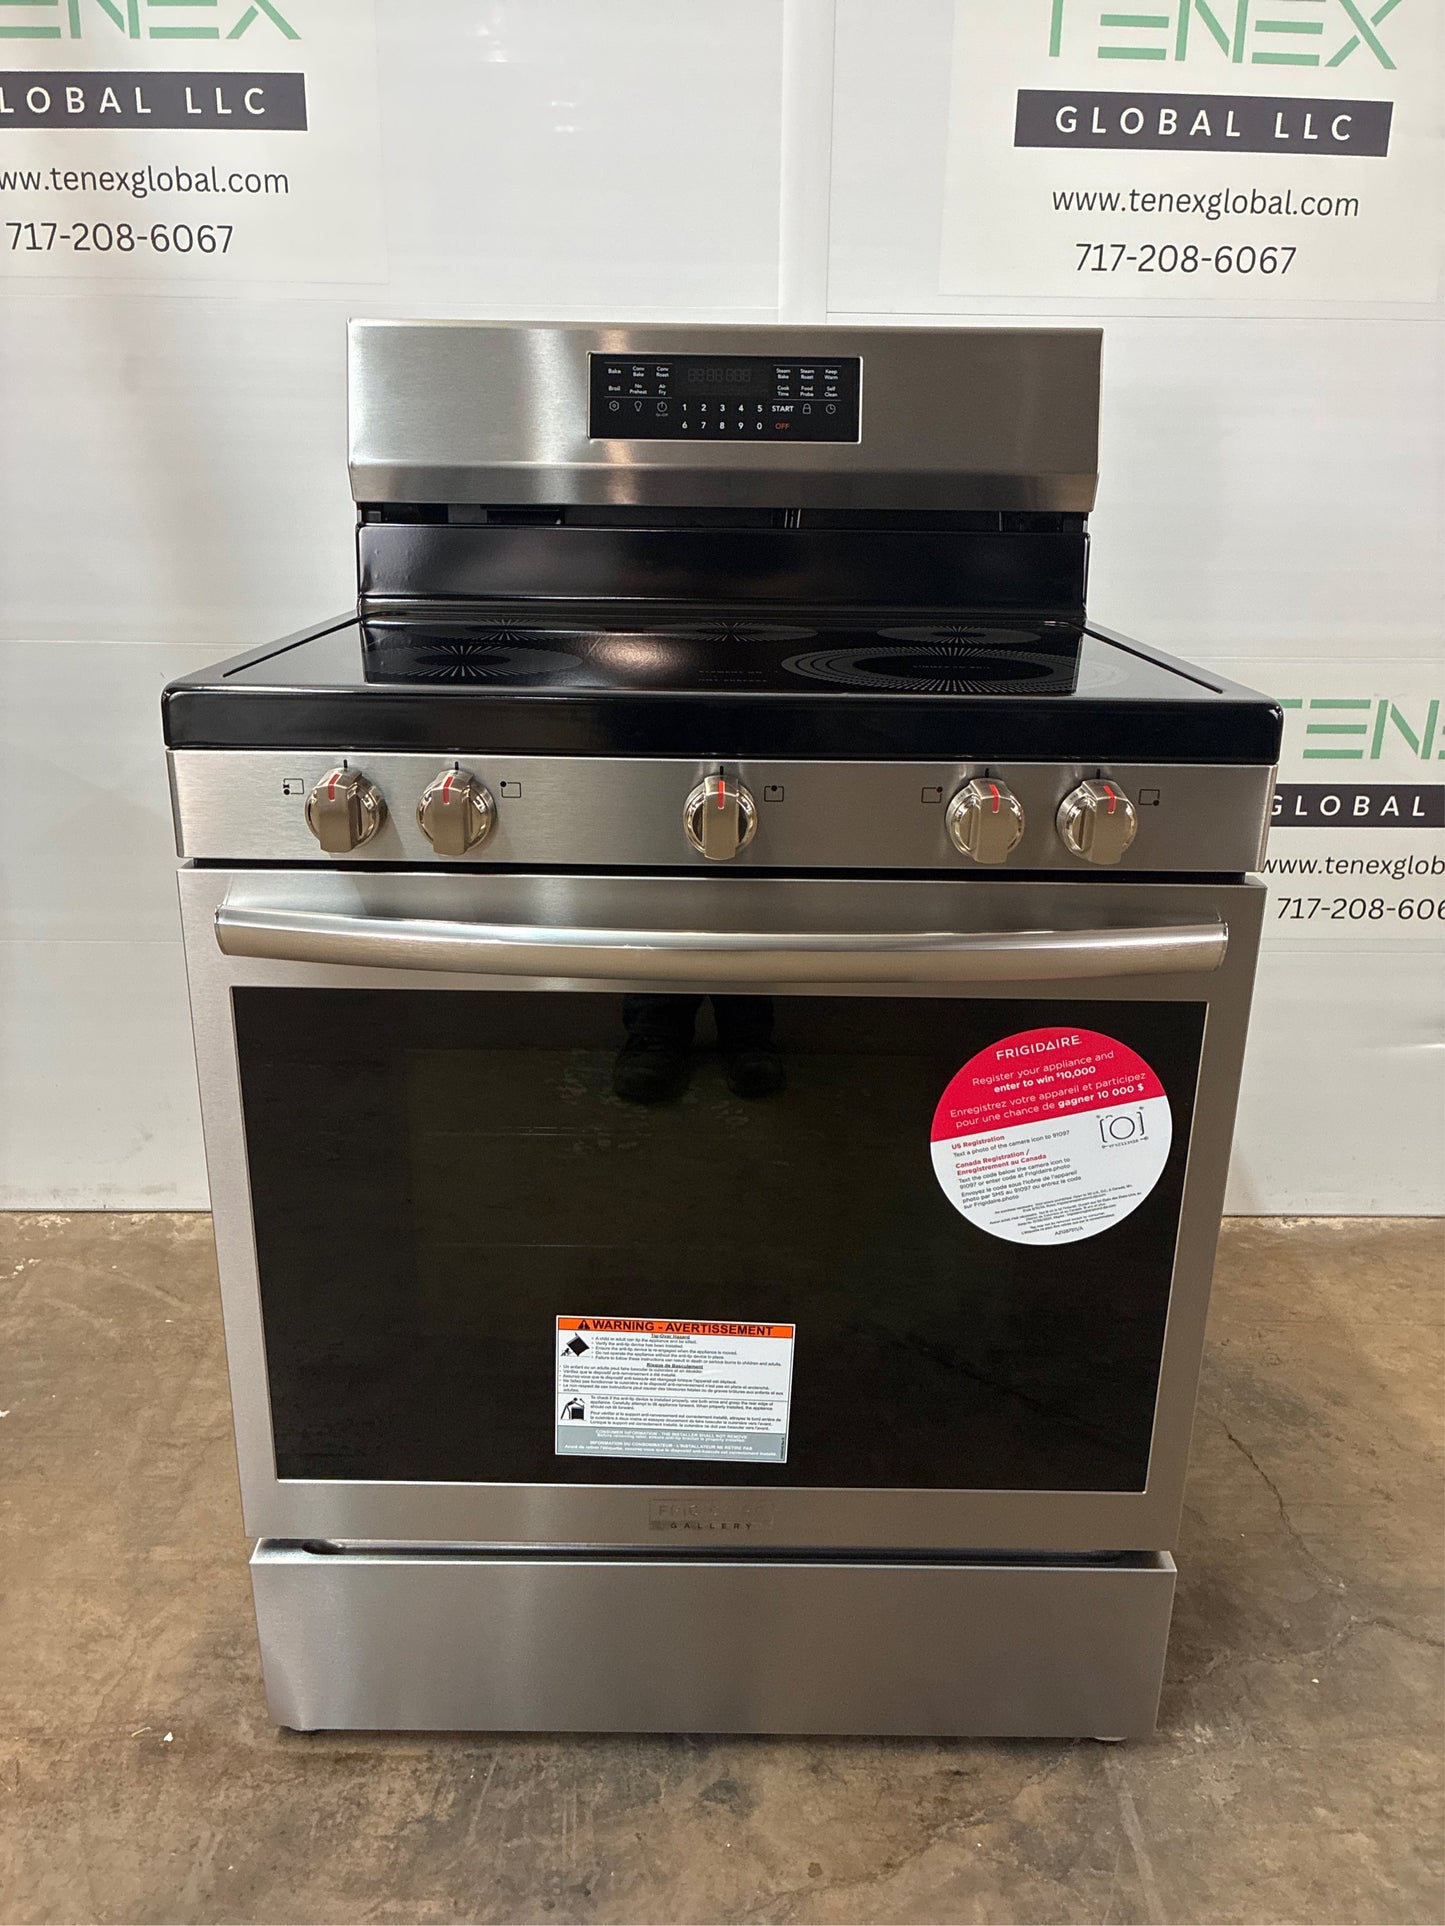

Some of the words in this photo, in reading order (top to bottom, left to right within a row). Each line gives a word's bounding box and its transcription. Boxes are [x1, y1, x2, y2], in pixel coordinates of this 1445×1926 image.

[185, 87, 266, 115] LLC
[1055, 106, 1241, 137] GLOBAL
[1274, 112, 1352, 141] LLC
[1052, 189, 1359, 220] www.tenexglobal.com
[5, 222, 234, 253] 717-208-6067
[1075, 244, 1297, 274] 717-208-6067
[682, 403, 687, 411] 1
[701, 403, 707, 412] 2
[720, 404, 726, 412] 3
[738, 404, 744, 412] 4
[757, 404, 763, 412] 5
[682, 421, 688, 429] 6
[701, 421, 706, 429] 7
[720, 422, 725, 430] 8
[738, 422, 744, 430] 9
[756, 422, 763, 430] 0
[1271, 795, 1425, 817] GLOBAL
[995, 1034, 1081, 1061] FRIGIDAIRE
[972, 1070, 1014, 1088] Register
[1017, 1067, 1041, 1079] your
[1042, 1055, 1093, 1073] appliance
[1094, 1050, 1114, 1062] and
[993, 1081, 1021, 1094] enter
[1022, 1078, 1035, 1088] to
[1035, 1074, 1055, 1085] win
[1055, 1064, 1097, 1082] $10,000
[950, 1099, 1007, 1119] Enregistrez
[1009, 1094, 1036, 1106] votre
[1038, 1085, 1080, 1101] appareil
[1081, 1083, 1092, 1092] et
[1095, 1072, 1146, 1090] participez
[955, 1117, 979, 1128] pour
[982, 1113, 1001, 1123] une
[1003, 1104, 1040, 1119] chance
[1041, 1101, 1055, 1111] de
[1057, 1094, 1095, 1109] gagner
[1097, 1089, 1110, 1100] 10
[1111, 1084, 1135, 1097] 000
[1137, 1082, 1145, 1092] $
[962, 1134, 1005, 1149] Registration
[971, 1147, 989, 1155] photo
[1008, 1139, 1030, 1147] camera
[1052, 1130, 1070, 1138] 91097
[955, 1158, 982, 1169] Canada
[982, 1150, 1025, 1165] Registration
[956, 1160, 1010, 1177] Enregistrement
[1020, 1153, 1047, 1164] Canada
[998, 1168, 1016, 1176] below
[1027, 1162, 1050, 1170] camera
[960, 1182, 977, 1190] 91097
[961, 1188, 985, 1198] Envoyez
[962, 1196, 980, 1204] photo
[1014, 1185, 1031, 1193] 91097
[1040, 1180, 1059, 1188] entrez
[1067, 1175, 1082, 1183] code
[592, 1319, 655, 1331] WARNING
[665, 1322, 773, 1336] AVERTISSEMENT
[670, 1522, 752, 1530] GALLERY
